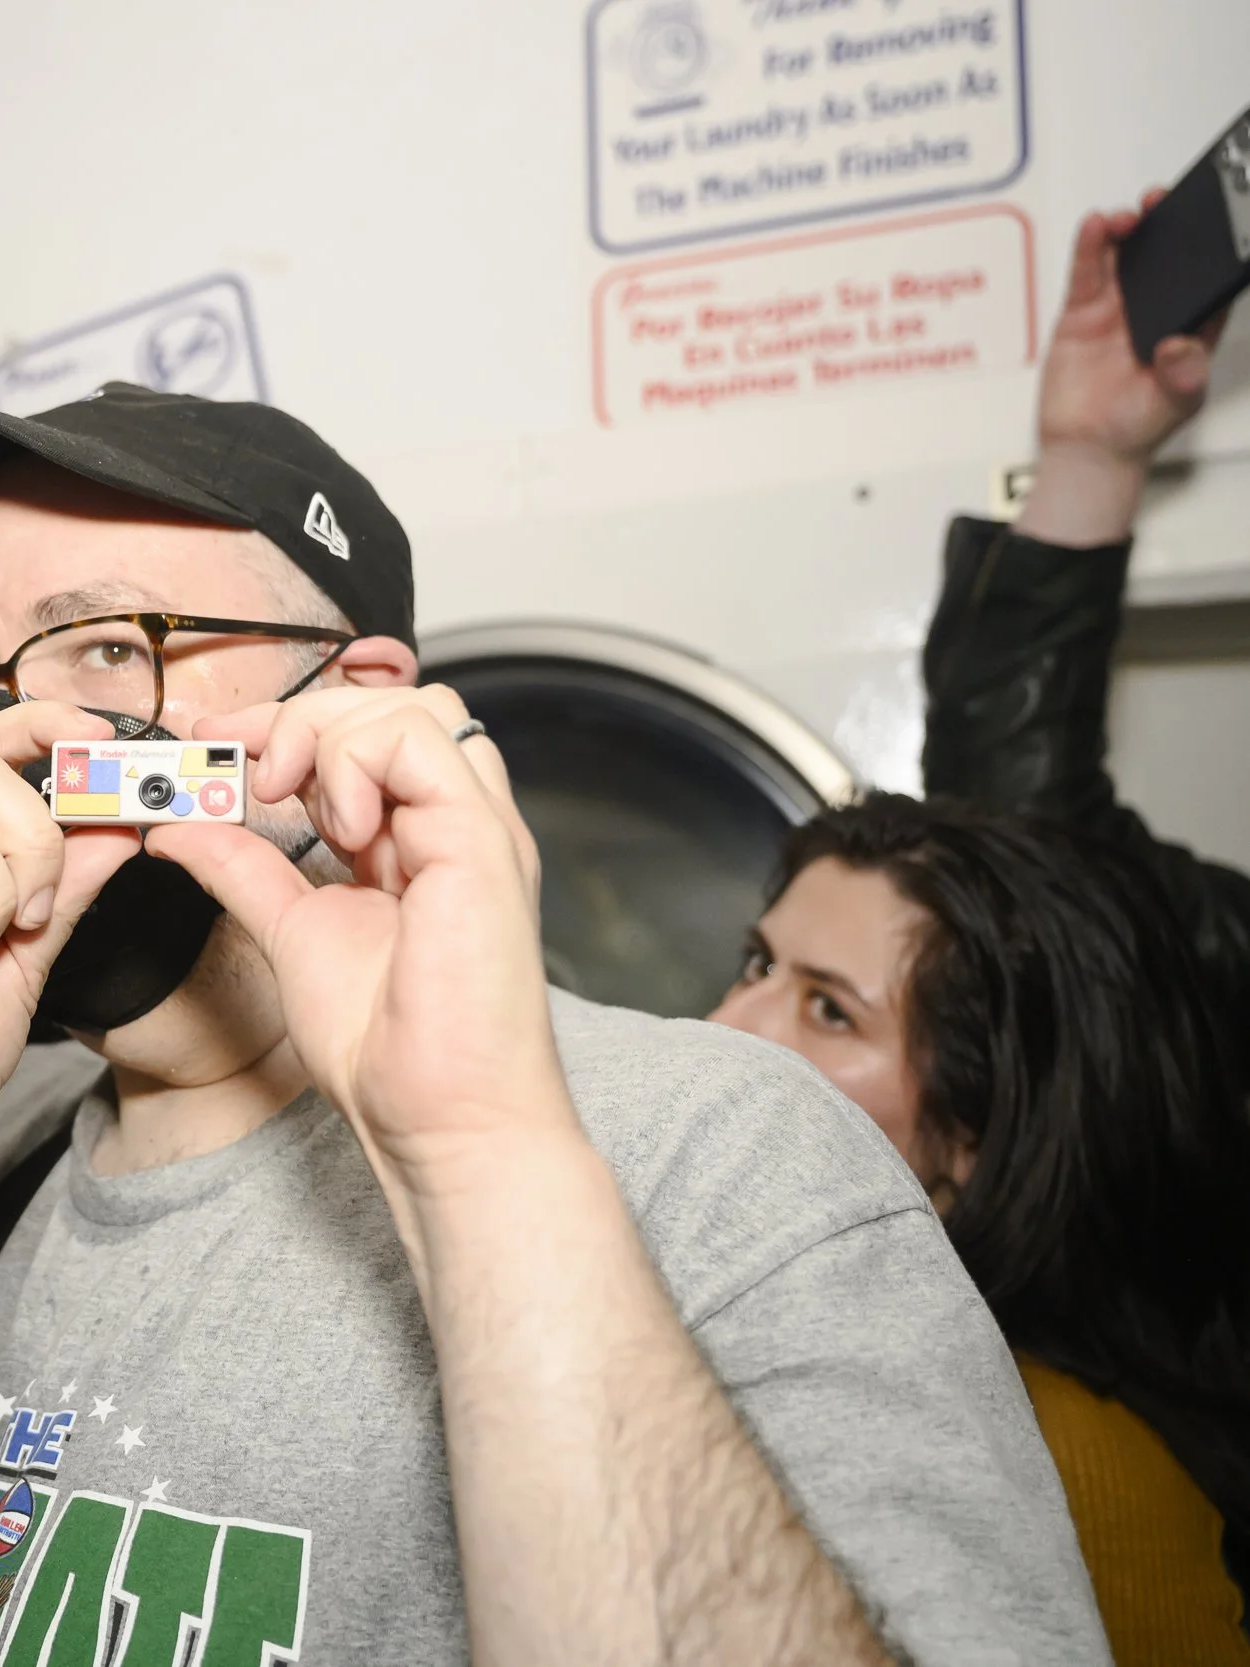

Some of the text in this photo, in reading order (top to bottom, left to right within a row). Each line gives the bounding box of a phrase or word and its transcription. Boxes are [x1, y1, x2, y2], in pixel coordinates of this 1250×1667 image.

[685, 106, 809, 153] Laundry
[698, 162, 826, 203] Machine
[100, 749, 128, 759] Kodak
